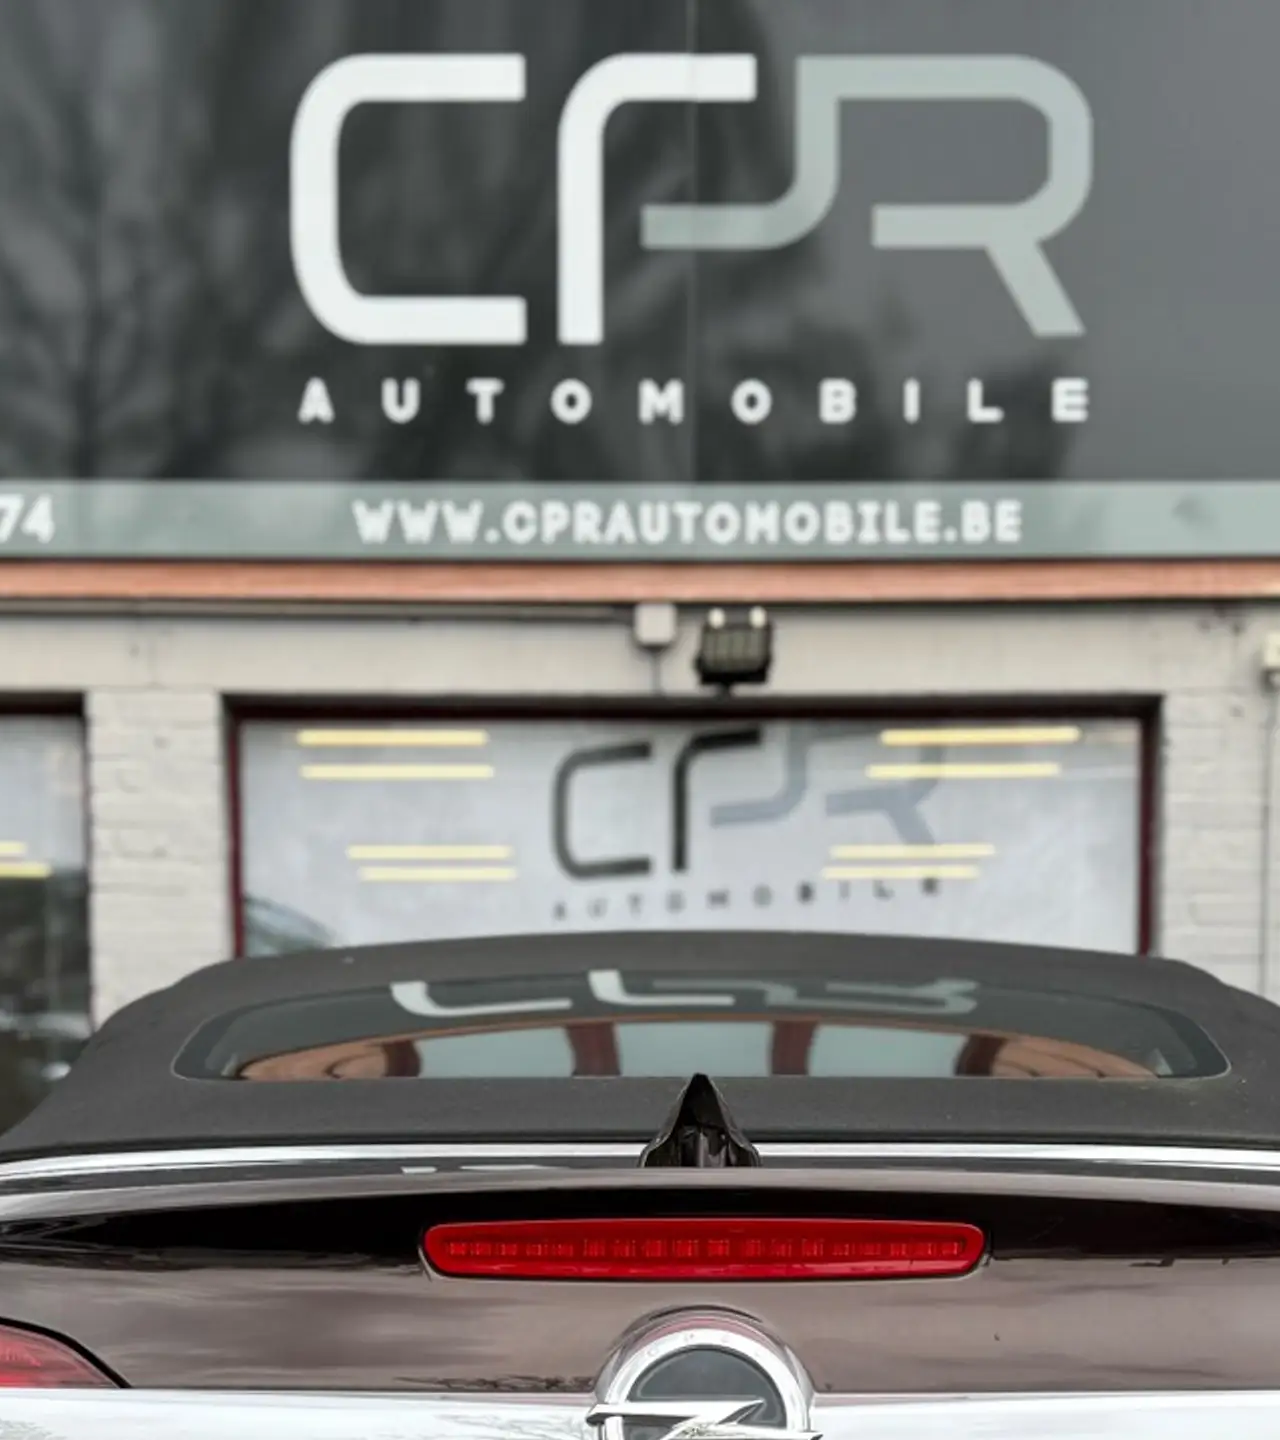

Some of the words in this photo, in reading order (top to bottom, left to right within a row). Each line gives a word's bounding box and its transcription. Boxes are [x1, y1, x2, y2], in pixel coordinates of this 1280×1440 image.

[290, 54, 1093, 345] CPR
[299, 379, 1089, 425] AUTOMOBILE
[352, 499, 1022, 545] WWW.CPRAUTOMOBILE.BE
